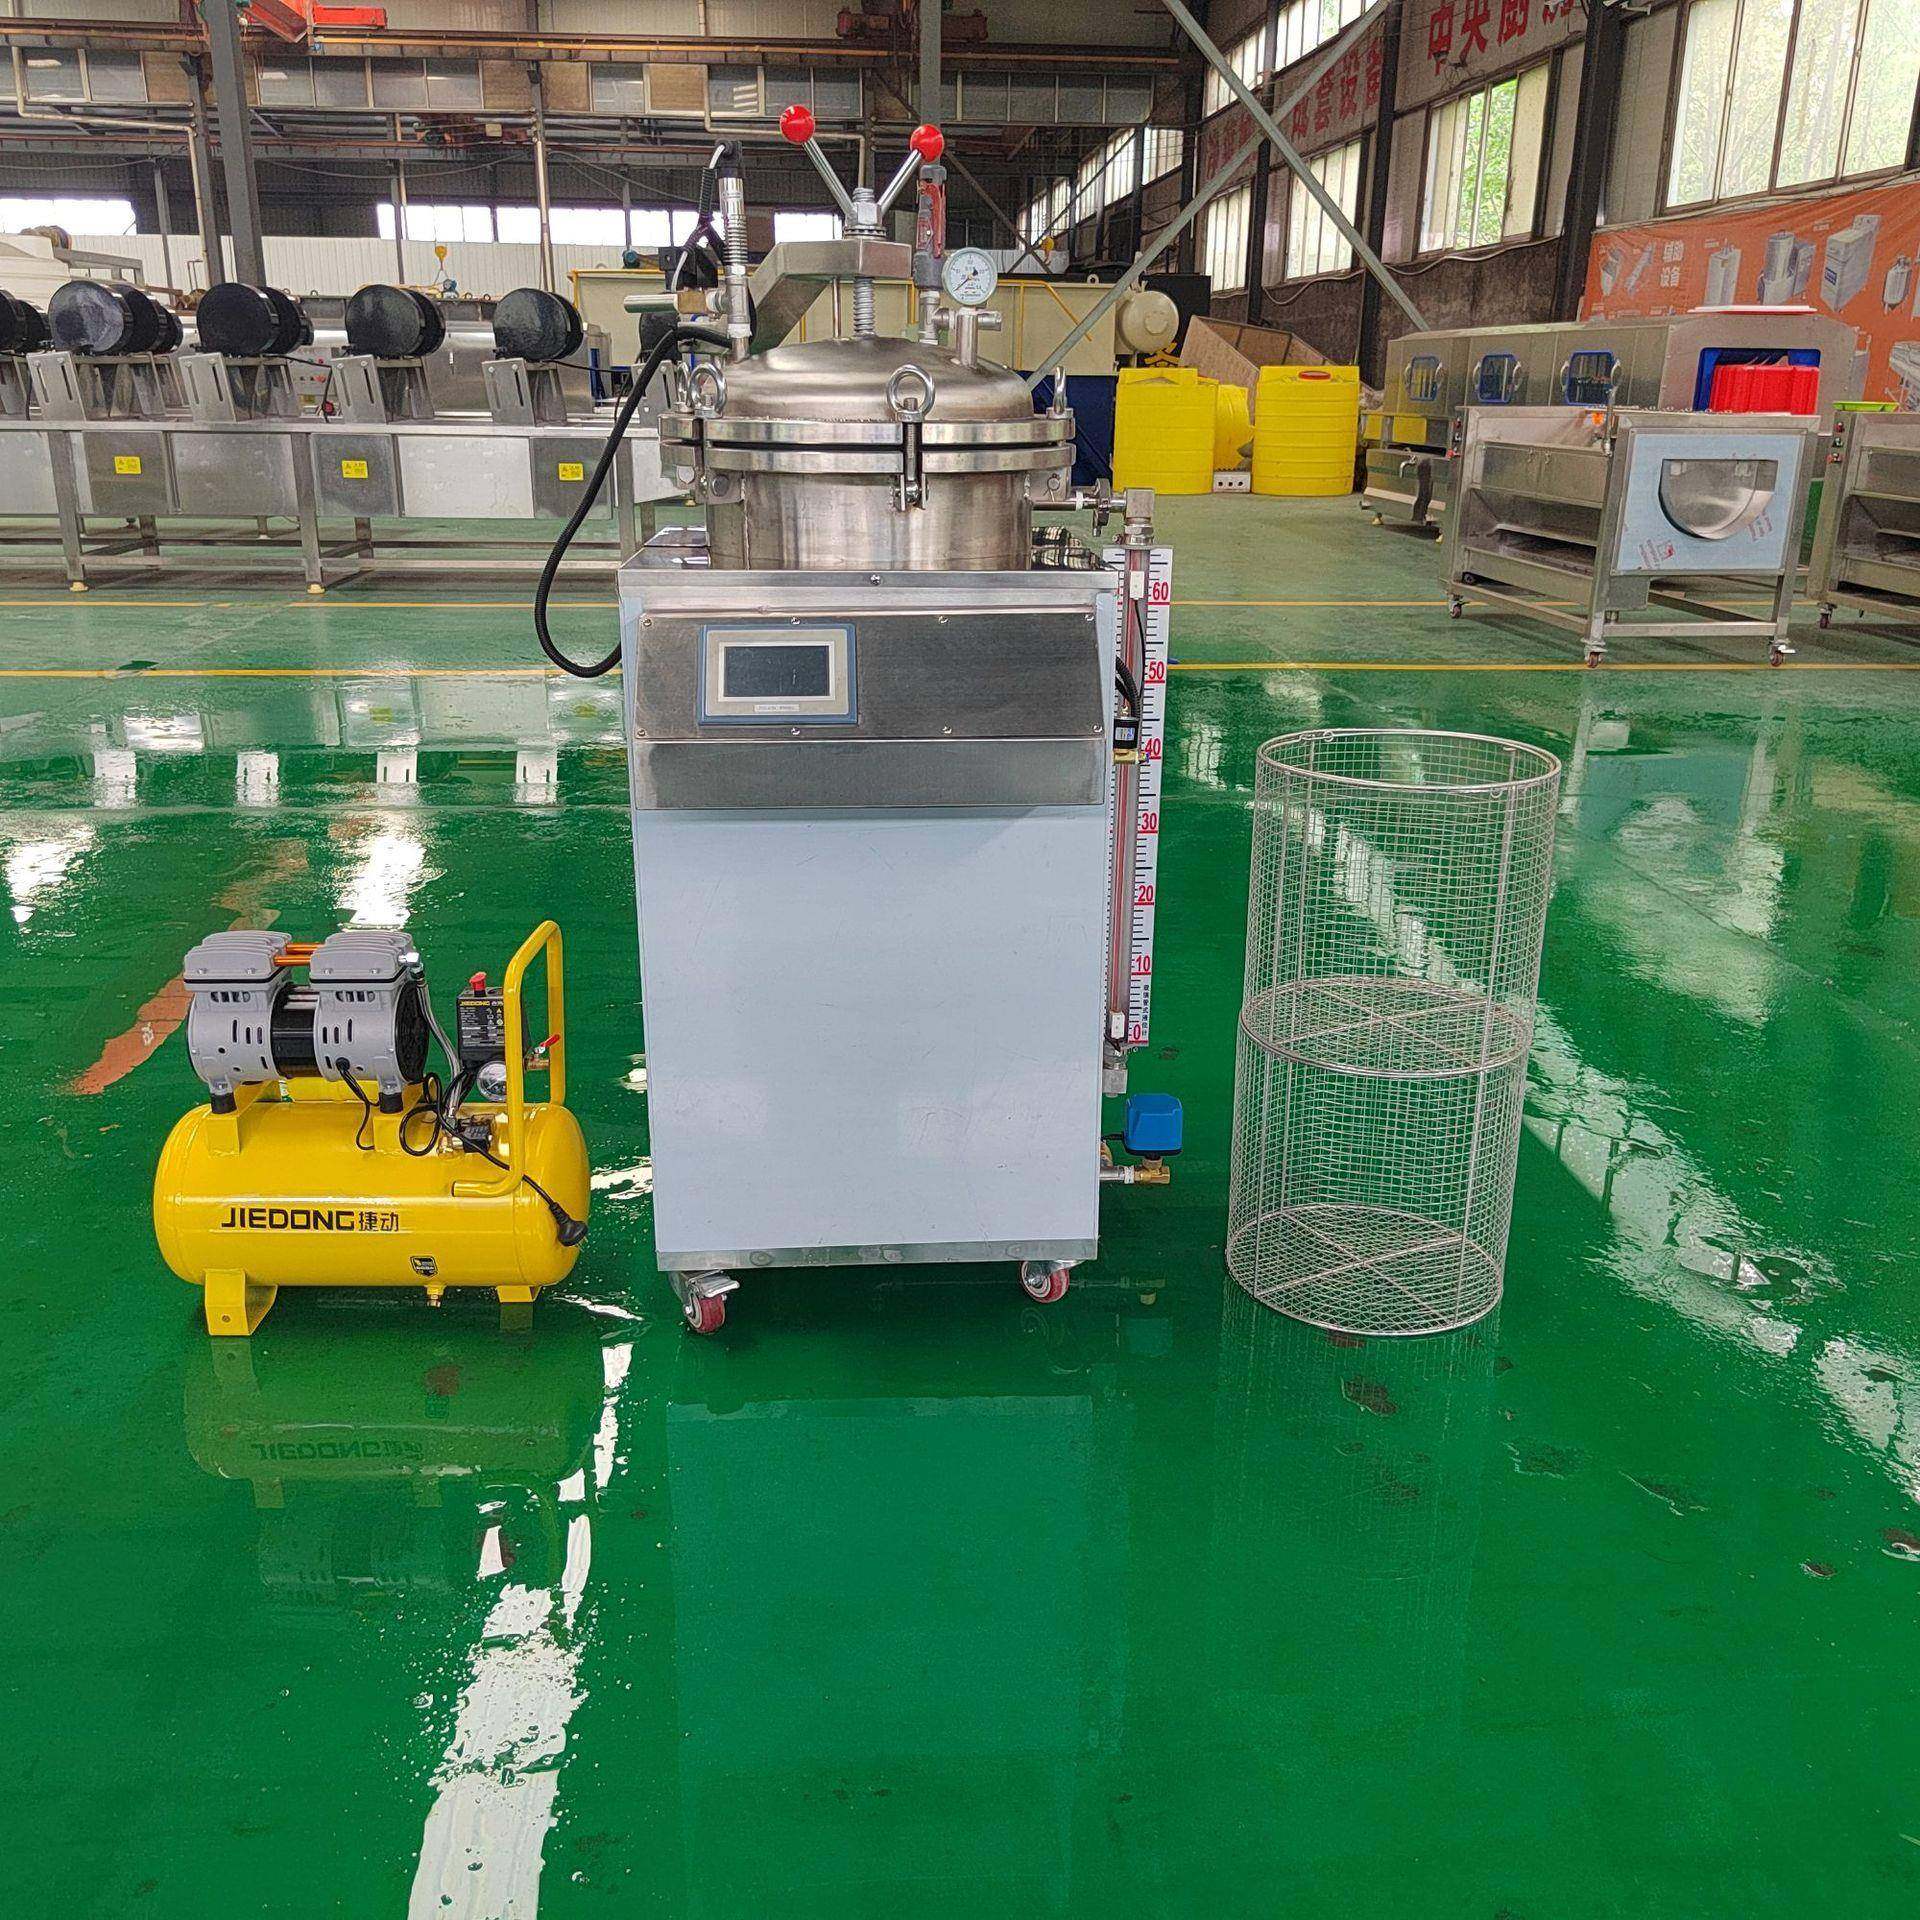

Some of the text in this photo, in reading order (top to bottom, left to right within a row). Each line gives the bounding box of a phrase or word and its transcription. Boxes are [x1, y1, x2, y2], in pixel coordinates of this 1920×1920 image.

[1660, 266, 1681, 288] 设备
[1152, 581, 1169, 600] 60
[1148, 661, 1165, 680] 50
[1144, 737, 1161, 756] 40
[1141, 812, 1158, 830] 30
[1138, 884, 1154, 901] 20
[1135, 955, 1151, 972] 10
[1133, 1023, 1141, 1040] 0
[221, 1207, 399, 1232] JIEDONG 捷动
